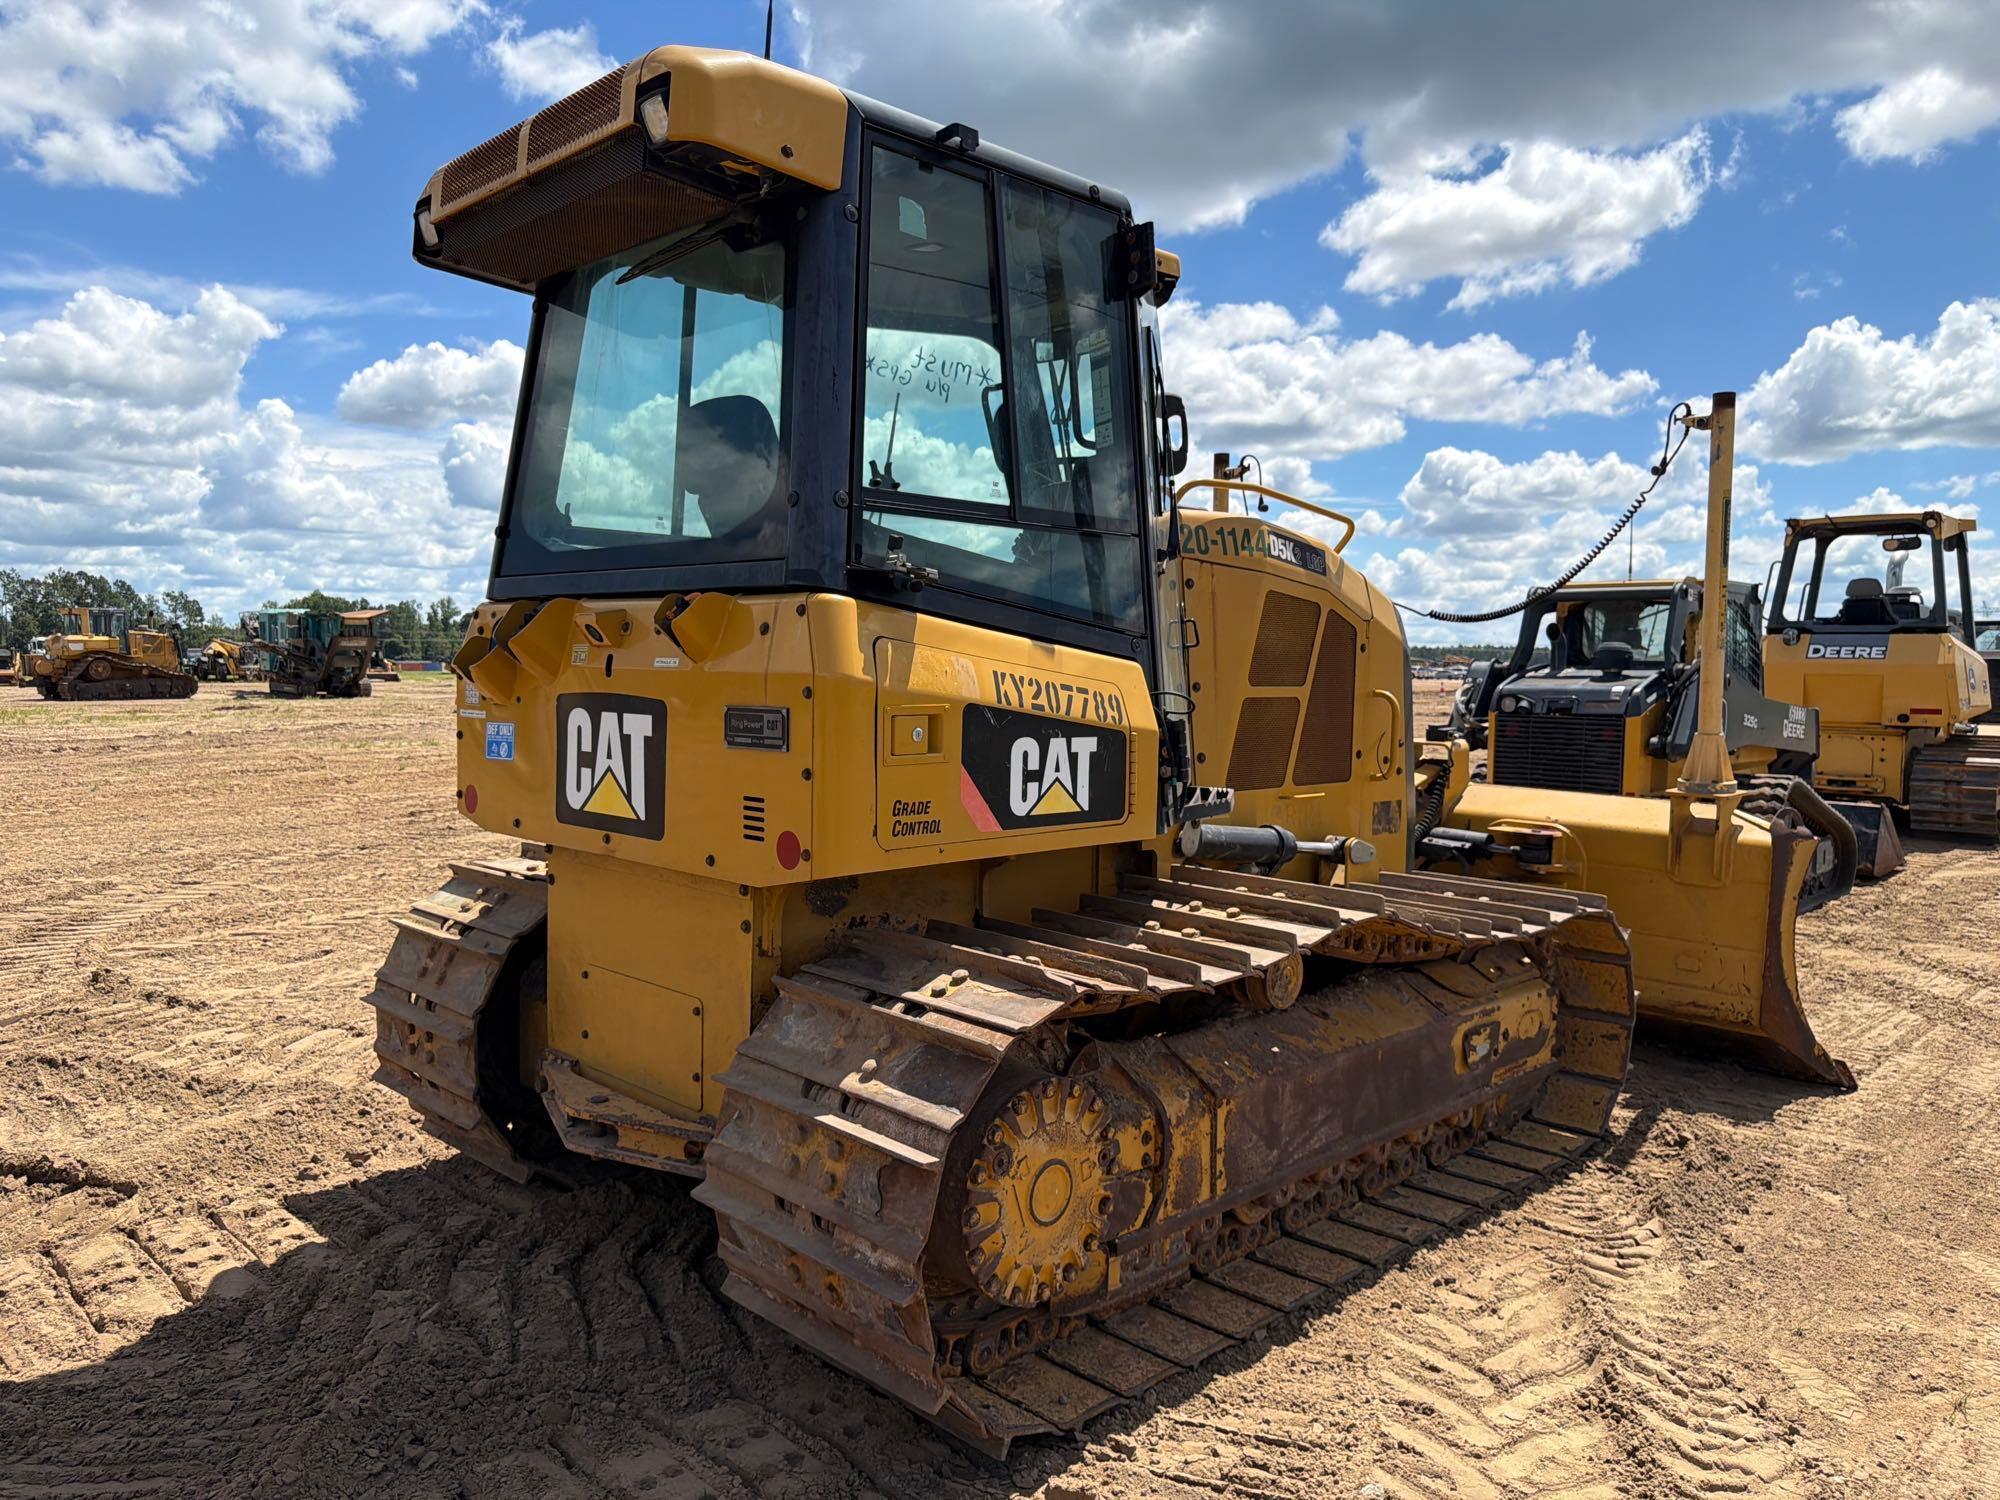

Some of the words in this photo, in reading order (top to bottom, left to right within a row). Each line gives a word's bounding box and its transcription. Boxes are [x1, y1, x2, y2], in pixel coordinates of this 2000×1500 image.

[1179, 523, 1268, 558] 20-1144
[1807, 644, 1887, 659] DEERE
[992, 670, 1124, 726] KY207789
[488, 723, 498, 736] DEF
[499, 724, 514, 736] ONLY
[1782, 719, 1806, 739] DEERE
[565, 707, 653, 822] CAT
[1009, 736, 1099, 817] CAT
